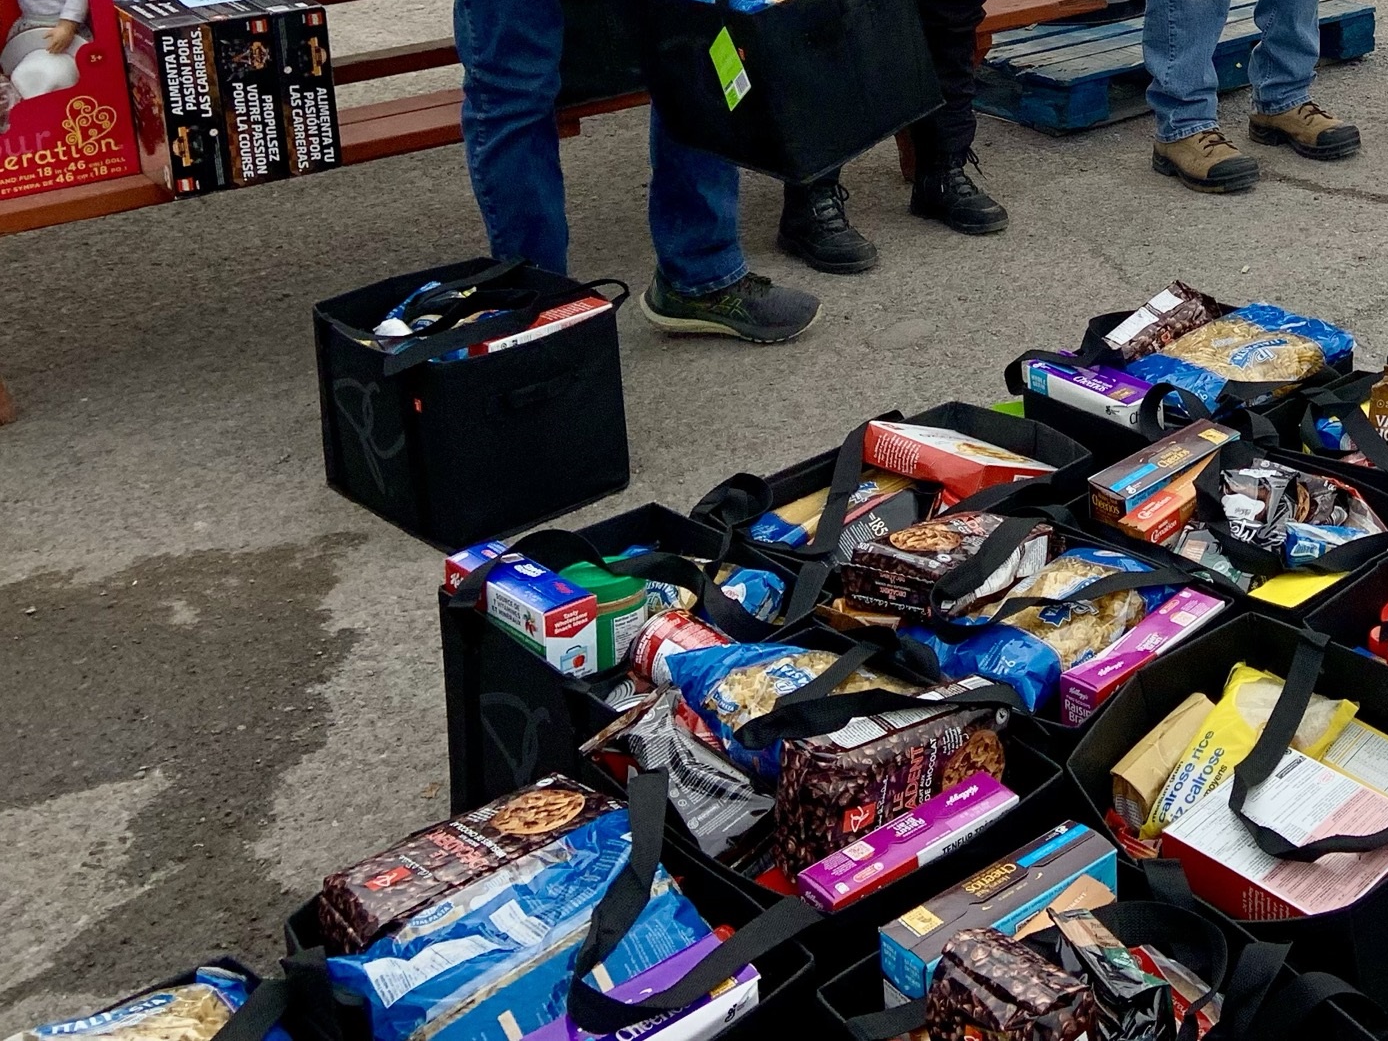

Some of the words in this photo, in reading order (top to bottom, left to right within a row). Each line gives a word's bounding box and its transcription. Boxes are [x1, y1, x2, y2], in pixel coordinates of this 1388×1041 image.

[161, 36, 175, 51] TU
[177, 39, 192, 63] POR
[190, 26, 209, 90] CARRERAS.
[163, 53, 185, 116] ALIMENTA
[179, 65, 198, 111] PASIÓN
[200, 91, 212, 118] LAS
[231, 82, 244, 114] POUR
[246, 83, 262, 123] VOTRE
[288, 85, 300, 110] LAS
[236, 115, 247, 132] LA
[261, 94, 281, 162] PROPULSEZ
[303, 91, 318, 133] PASIÓN
[316, 86, 332, 144] ALIMENTA
[324, 145, 336, 163] TU
[0, 130, 51, 156] ur
[238, 133, 255, 182] COURSE.
[251, 123, 269, 175] PASSION
[291, 110, 310, 172] CARRERAS.
[309, 135, 321, 161] POR
[37, 167, 53, 178] 18
[55, 172, 74, 184] 46
[1068, 711, 1084, 725] Bra
[904, 746, 926, 809] ADENT
[925, 738, 938, 787] CHOCOLAT
[1158, 761, 1195, 823] calrose
[1192, 729, 1215, 760] rice
[1184, 746, 1225, 805] calrose
[965, 863, 1017, 894] Cheerios
